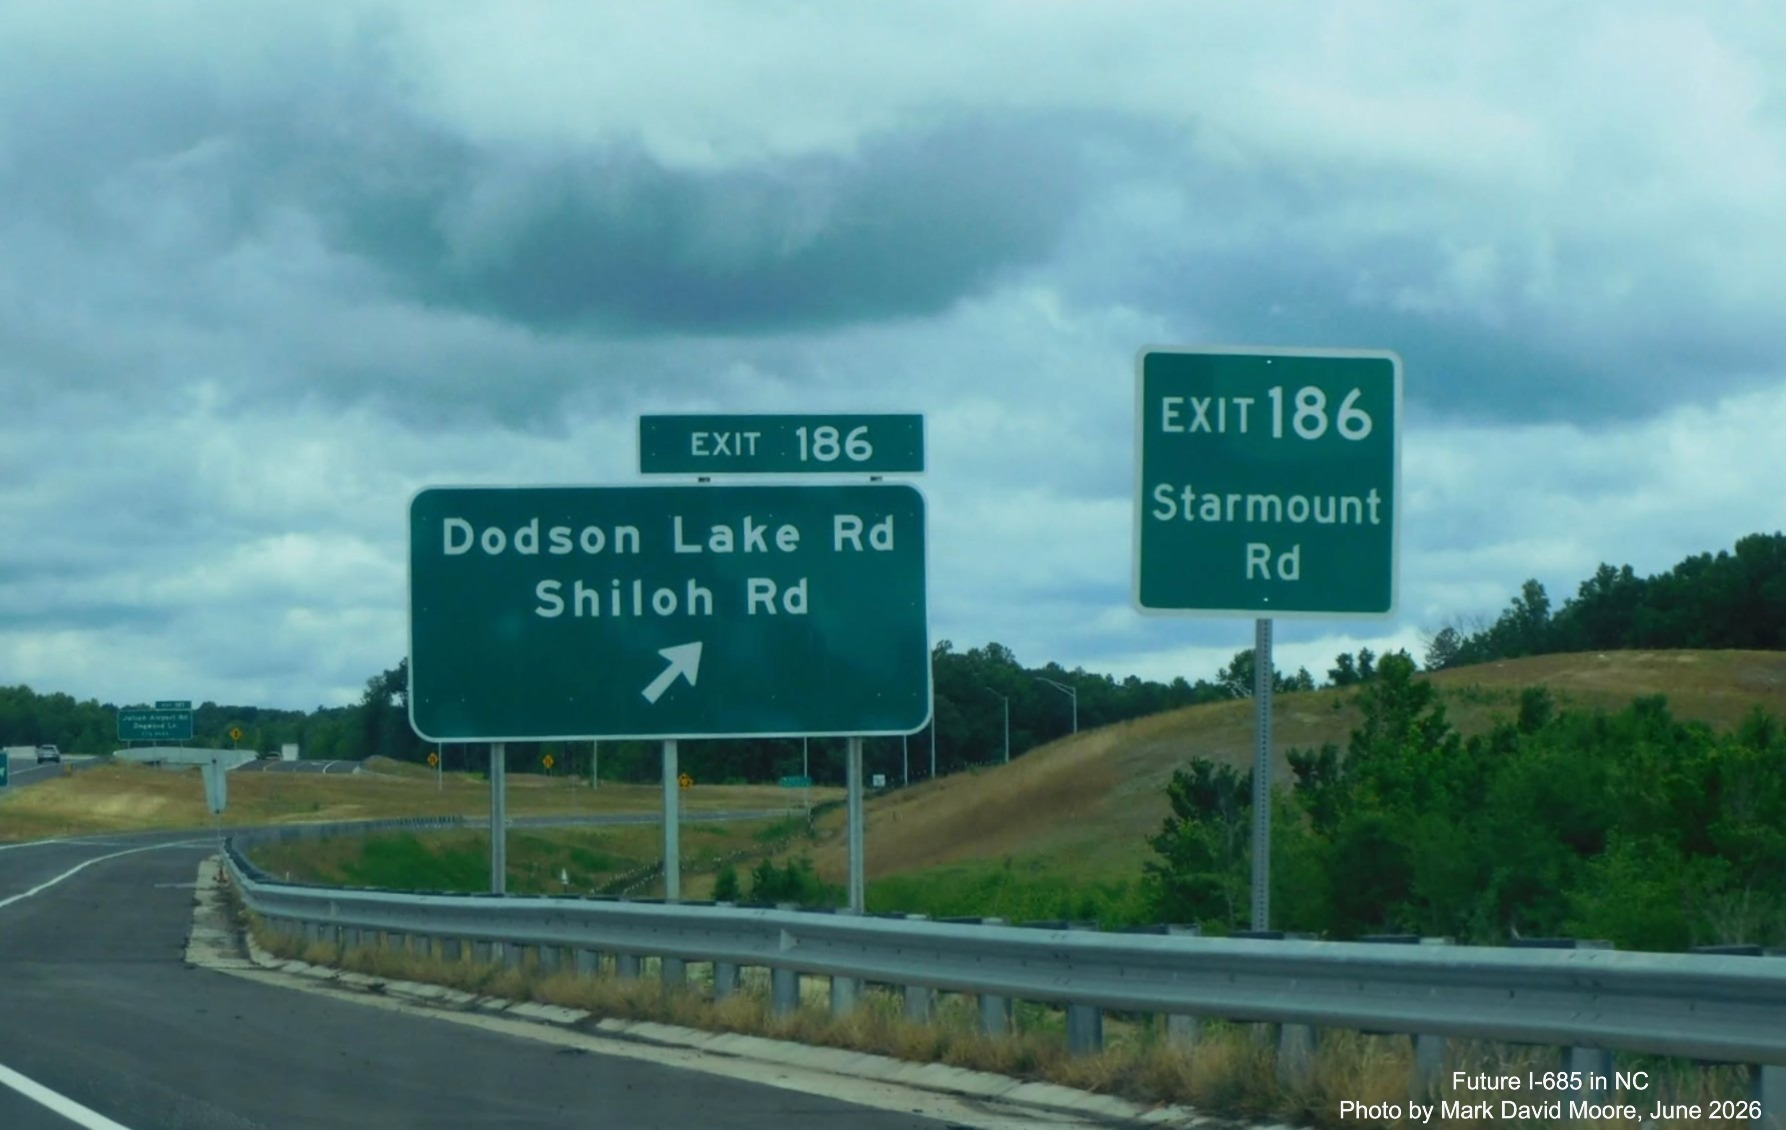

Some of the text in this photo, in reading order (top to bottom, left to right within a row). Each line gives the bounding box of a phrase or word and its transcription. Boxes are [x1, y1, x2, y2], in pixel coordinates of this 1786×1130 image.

[1163, 386, 1372, 440] EXIT 186
[692, 426, 872, 461] EXIT 186
[1154, 484, 1380, 523] Starmount
[444, 515, 893, 554] Dodson Lake Rd
[1248, 544, 1299, 580] Rd
[536, 578, 807, 617] Shiloh Rd
